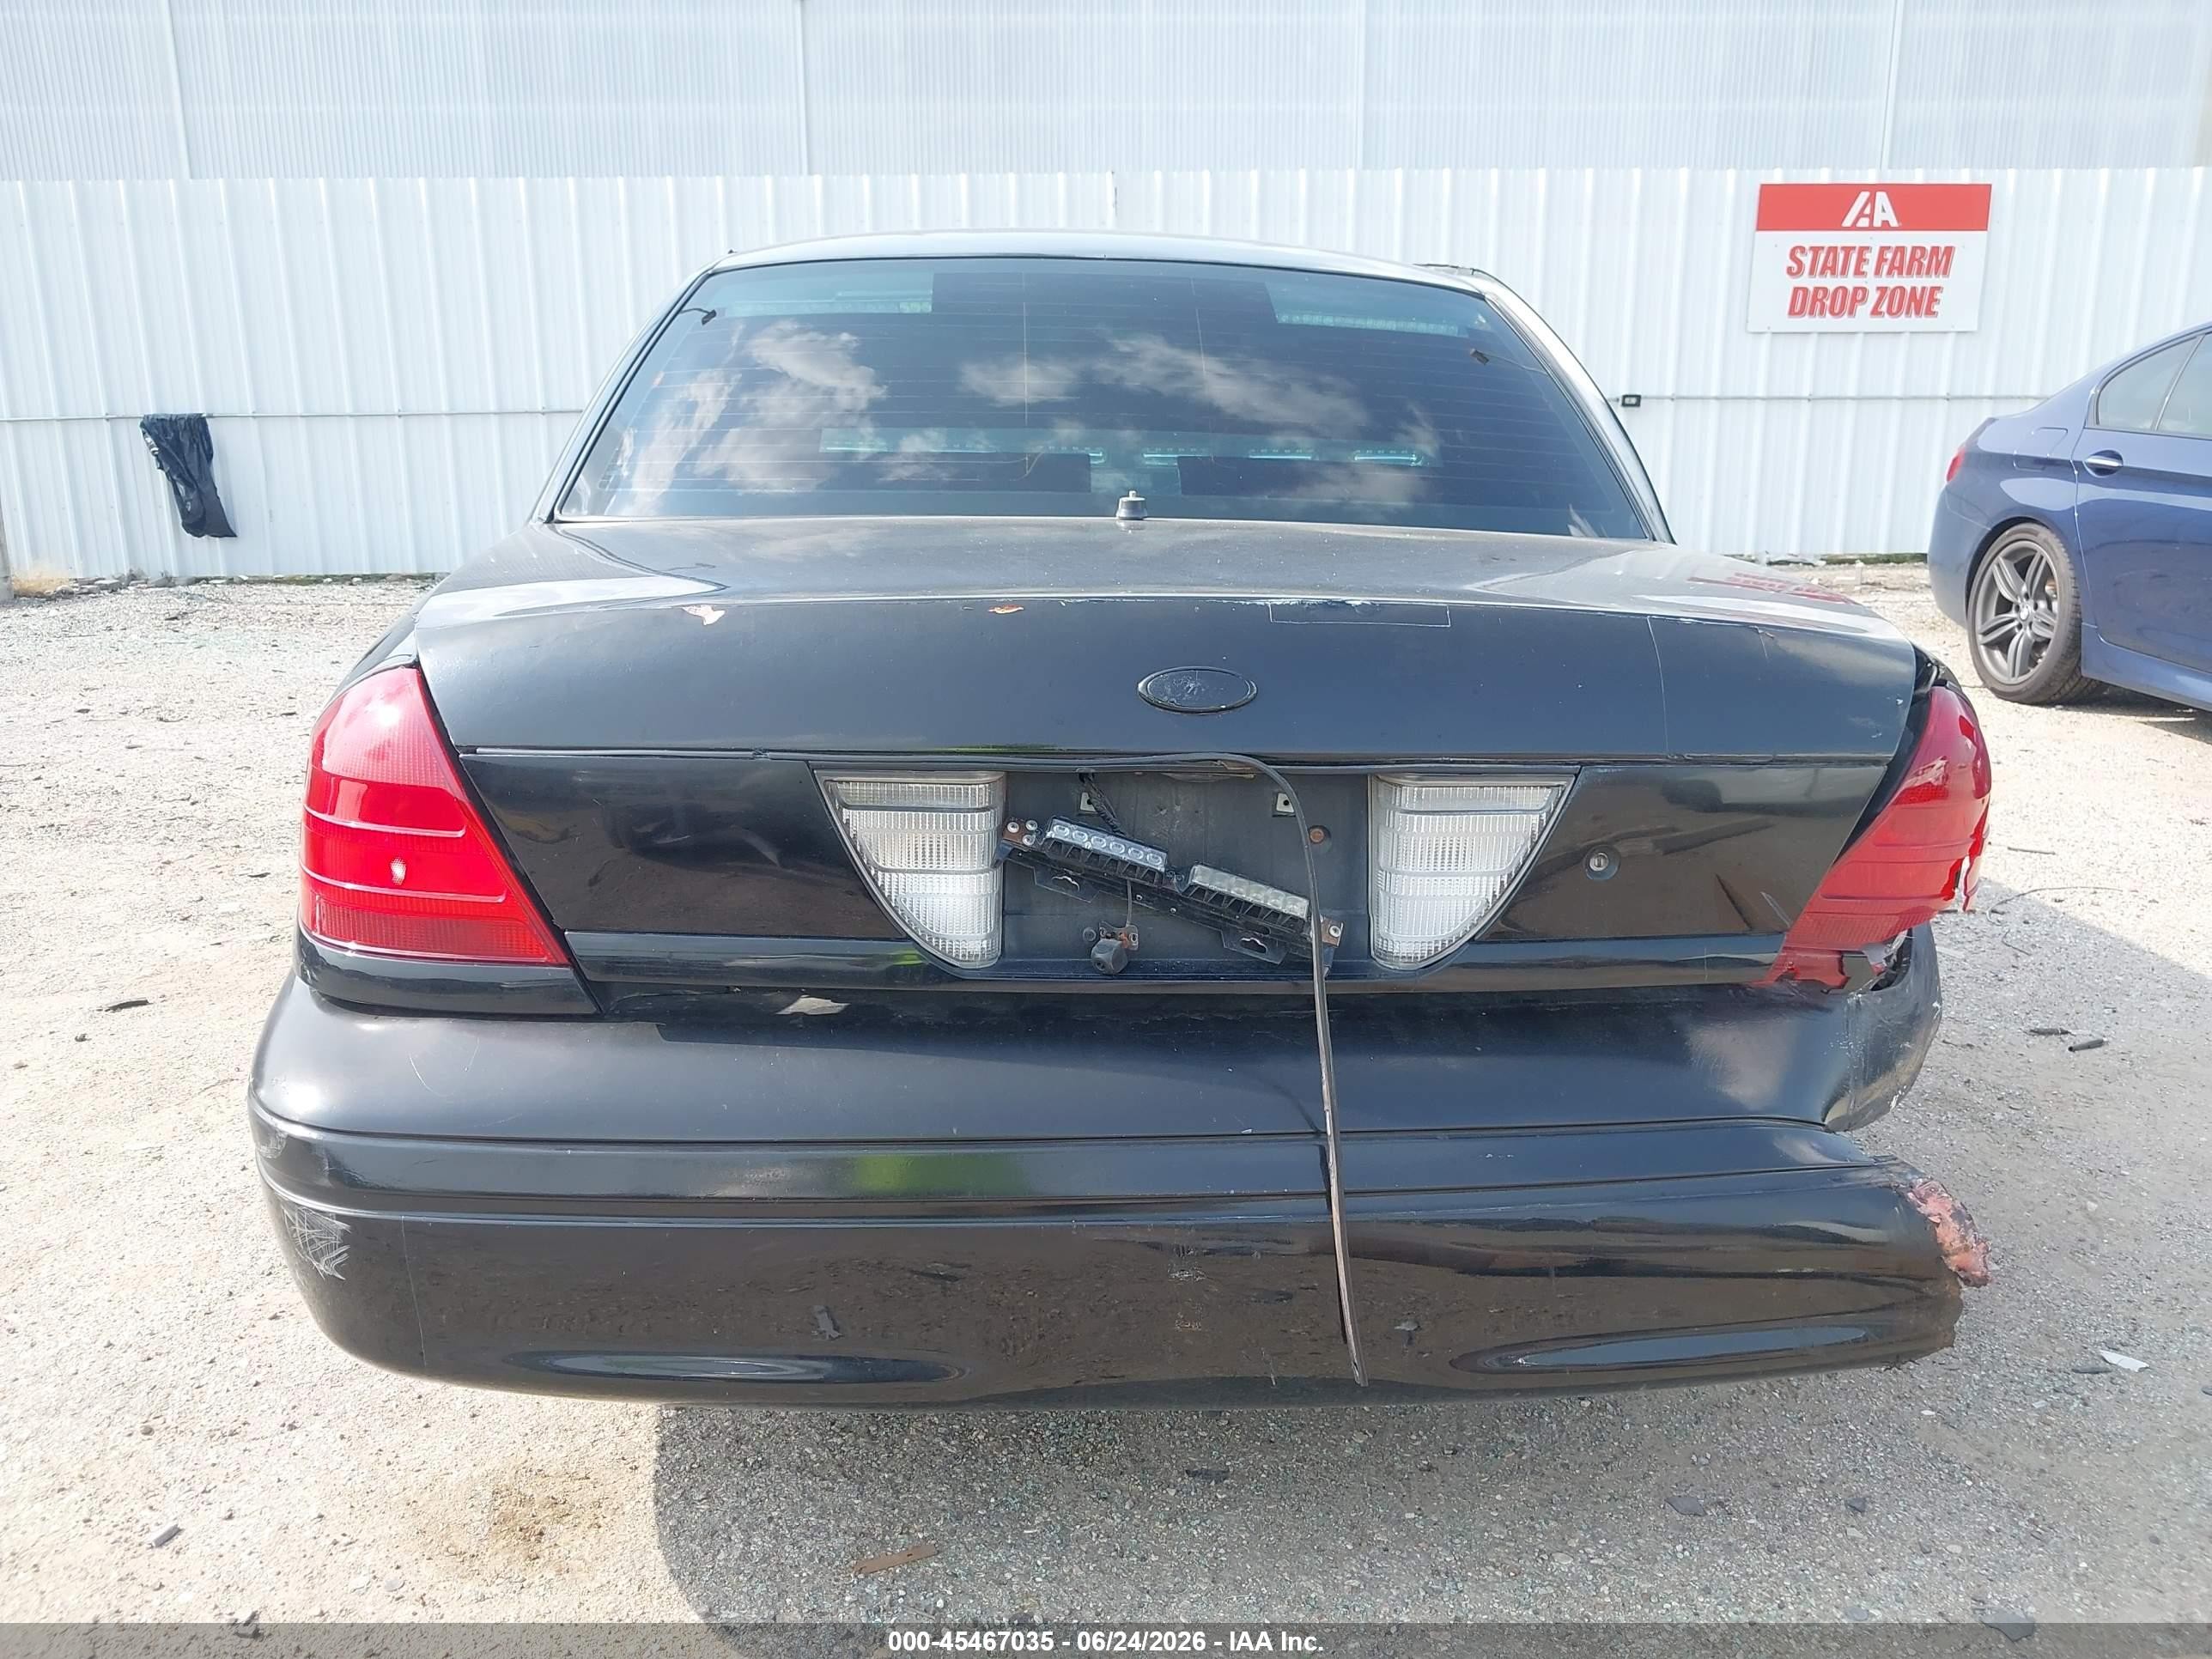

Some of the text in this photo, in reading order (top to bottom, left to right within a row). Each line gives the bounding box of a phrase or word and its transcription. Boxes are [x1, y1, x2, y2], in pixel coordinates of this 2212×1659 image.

[1786, 246, 1954, 277] STATE FARM
[1788, 286, 1942, 318] DROP ZONE
